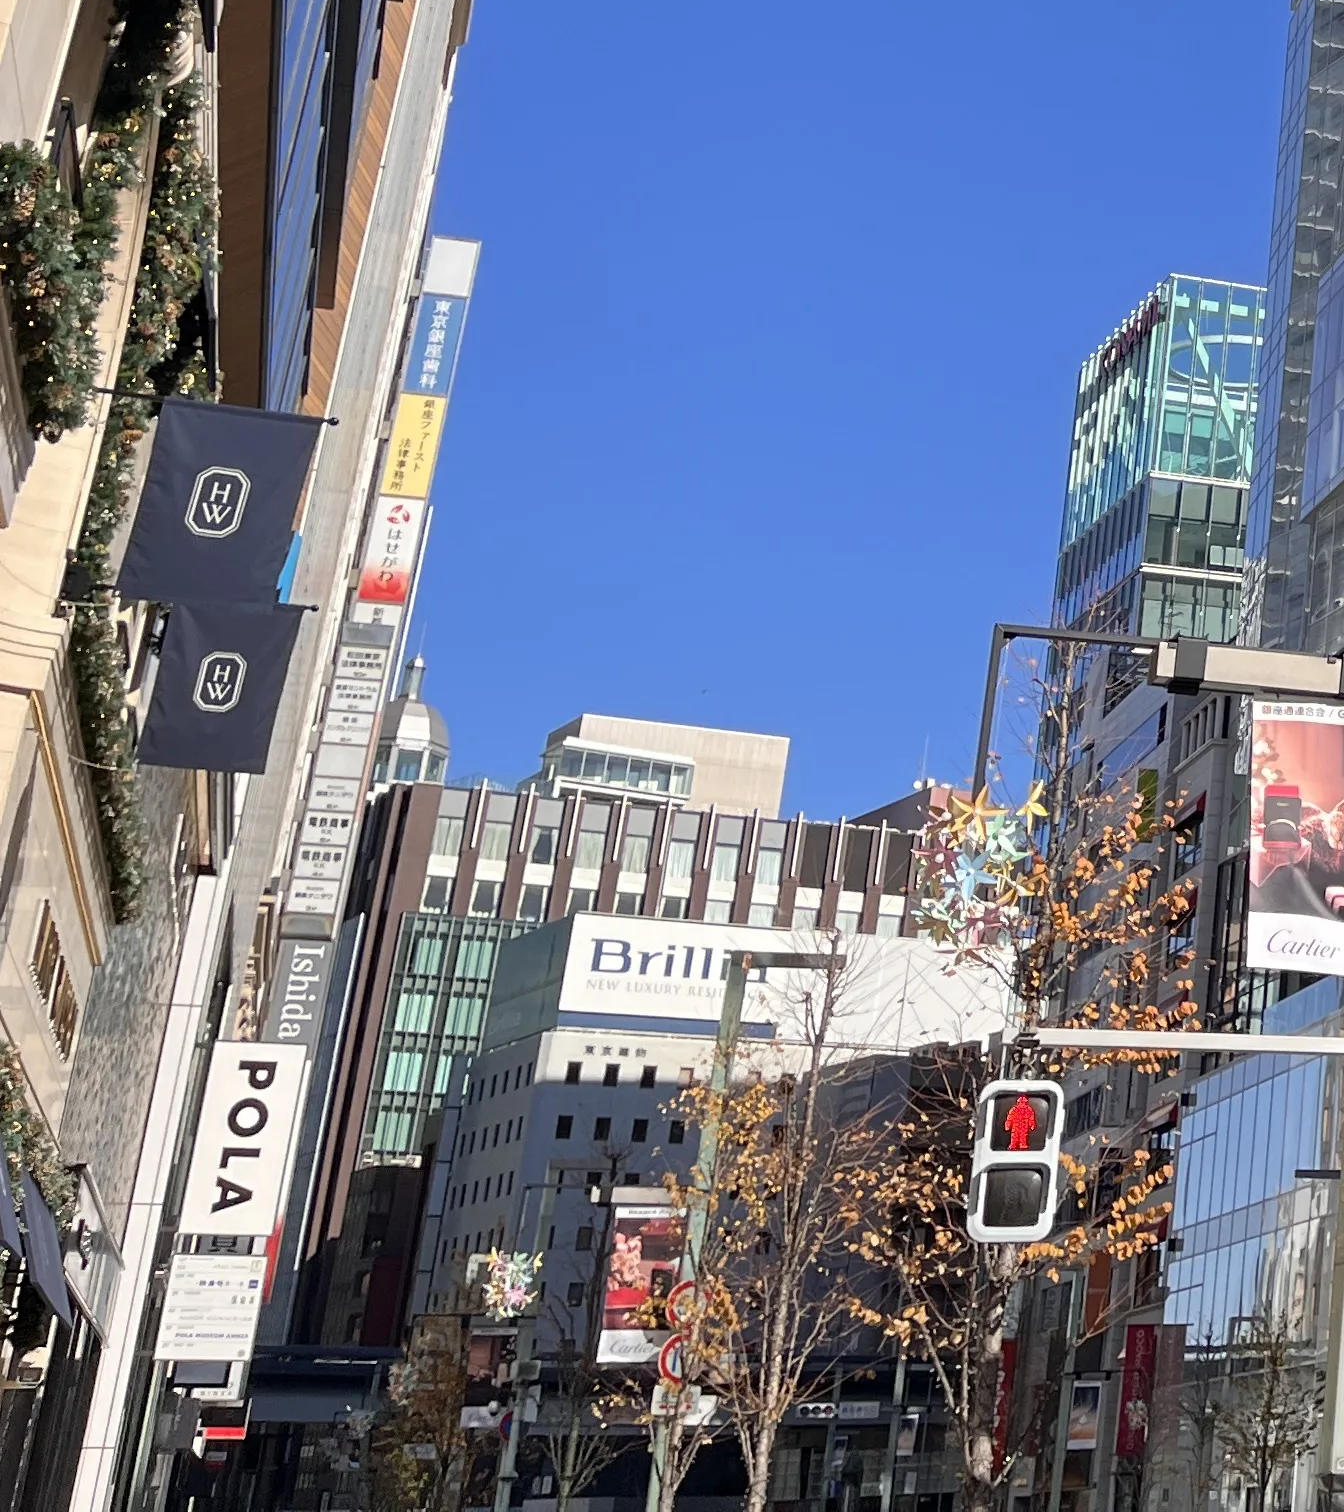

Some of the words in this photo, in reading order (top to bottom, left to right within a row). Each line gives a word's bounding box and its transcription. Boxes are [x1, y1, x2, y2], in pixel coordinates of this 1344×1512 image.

[418, 300, 453, 390] 東京銀座歯科
[390, 437, 412, 492] 法律事務所
[412, 399, 436, 473] 銀座ファースト
[379, 527, 403, 583] はせがわ
[1265, 928, 1341, 961] Cartier
[277, 943, 326, 1041] Ishida
[586, 978, 621, 991] NEW
[626, 979, 682, 996] LUXURY
[210, 1059, 278, 1215] POLA
